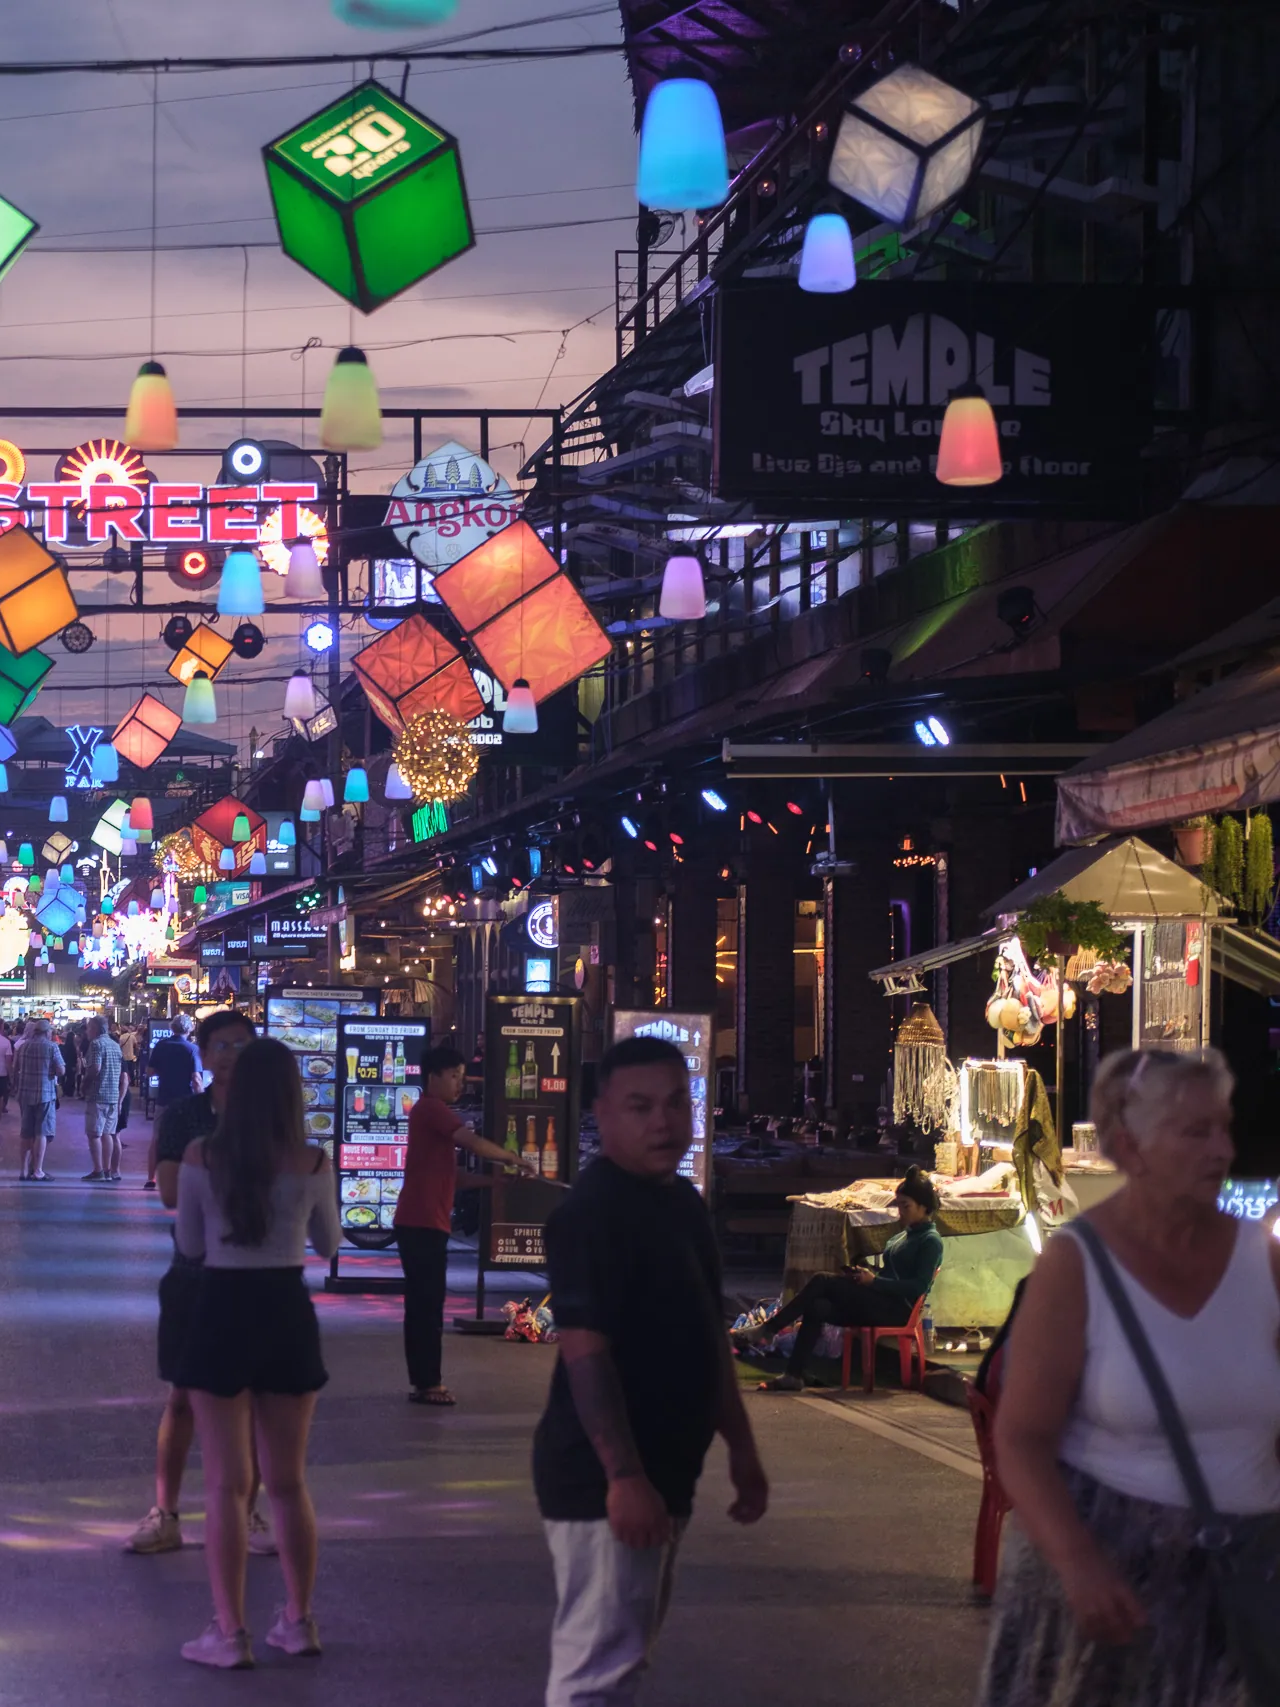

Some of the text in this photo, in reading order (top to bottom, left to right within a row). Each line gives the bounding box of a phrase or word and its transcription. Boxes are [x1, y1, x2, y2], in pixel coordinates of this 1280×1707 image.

[792, 313, 1051, 406] TEMPLE
[820, 411, 1022, 442] Sky Loue
[753, 452, 811, 476] Live
[382, 498, 524, 537] Angkor
[65, 724, 104, 776] X
[511, 1003, 555, 1019] TEMPLE
[634, 1019, 690, 1042] TEMPLE
[357, 1067, 377, 1078] $0.75
[543, 1079, 565, 1091] $1.00
